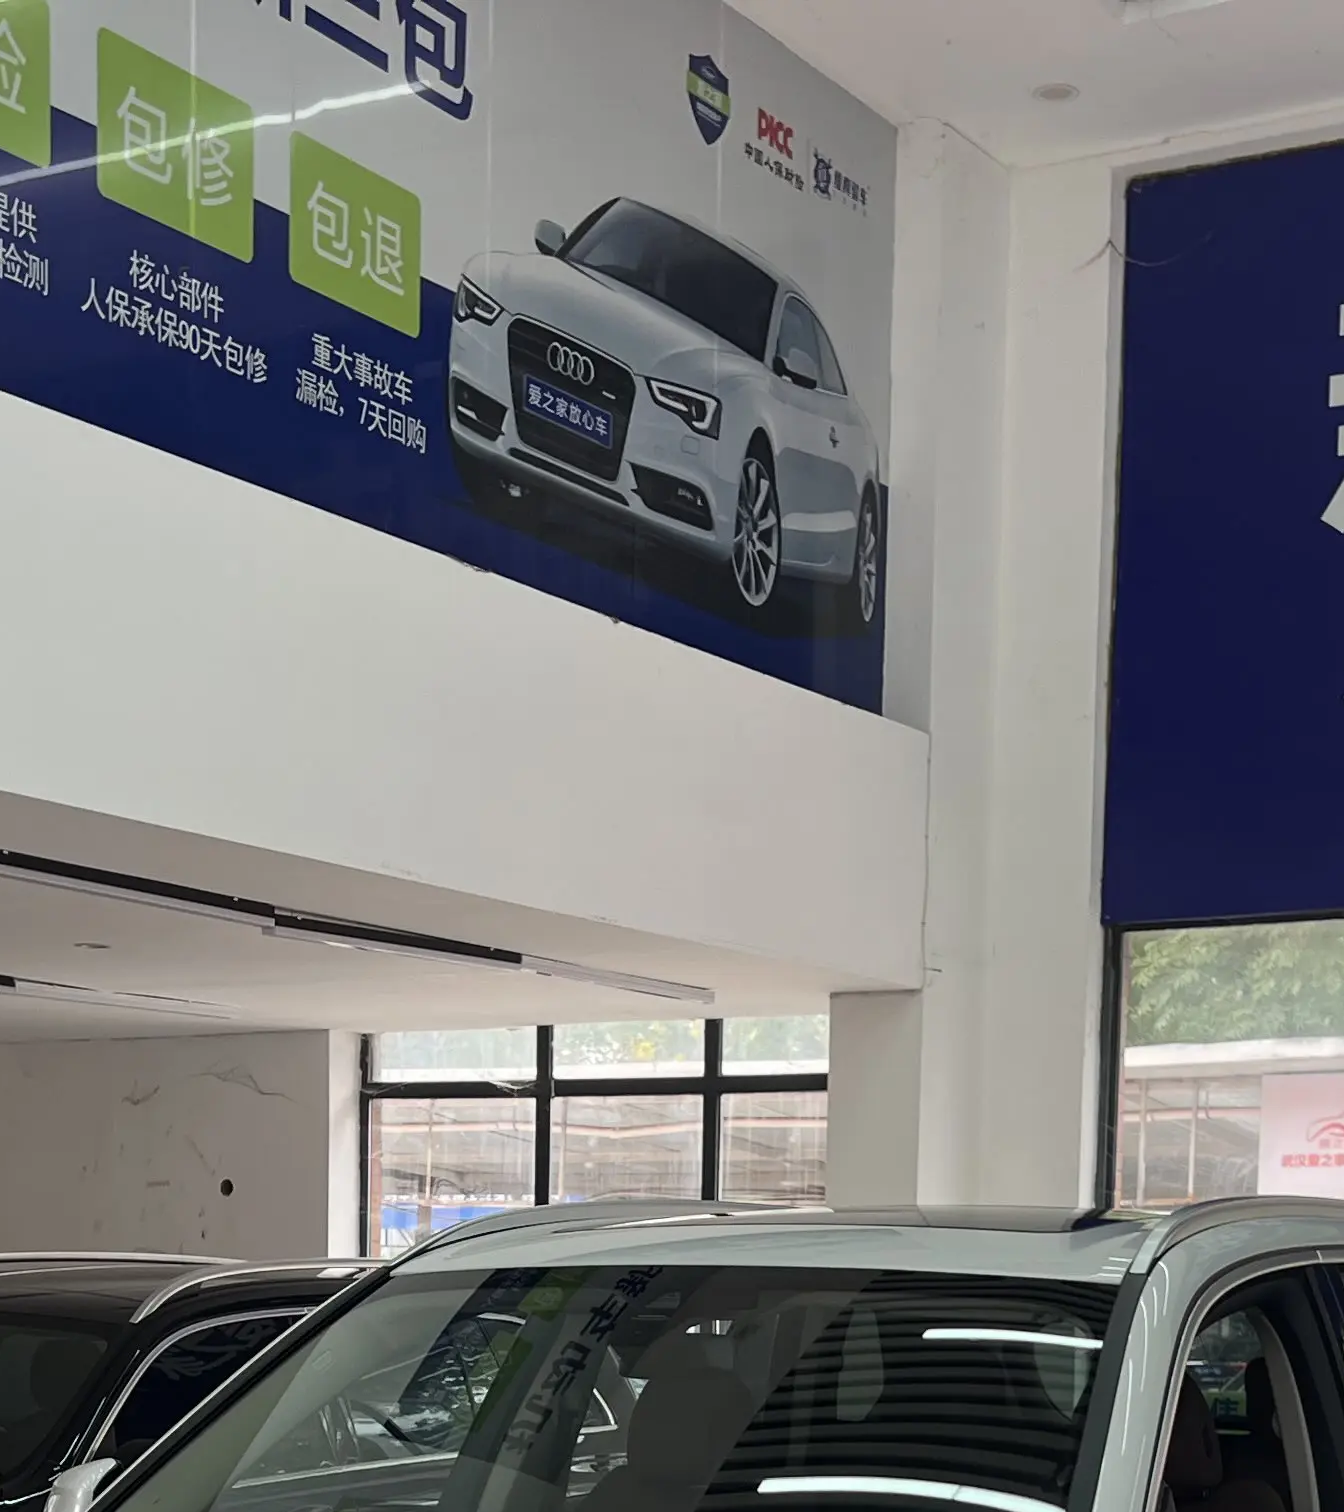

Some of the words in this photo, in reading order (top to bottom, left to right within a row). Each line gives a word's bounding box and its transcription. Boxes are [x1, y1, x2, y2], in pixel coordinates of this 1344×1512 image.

[116, 85, 234, 206] 包修
[757, 106, 795, 160] PICC
[307, 180, 405, 296] 包退
[80, 277, 268, 384] 人保承保90天包修
[128, 249, 225, 323] 核心部件
[311, 332, 414, 406] 重大事故车
